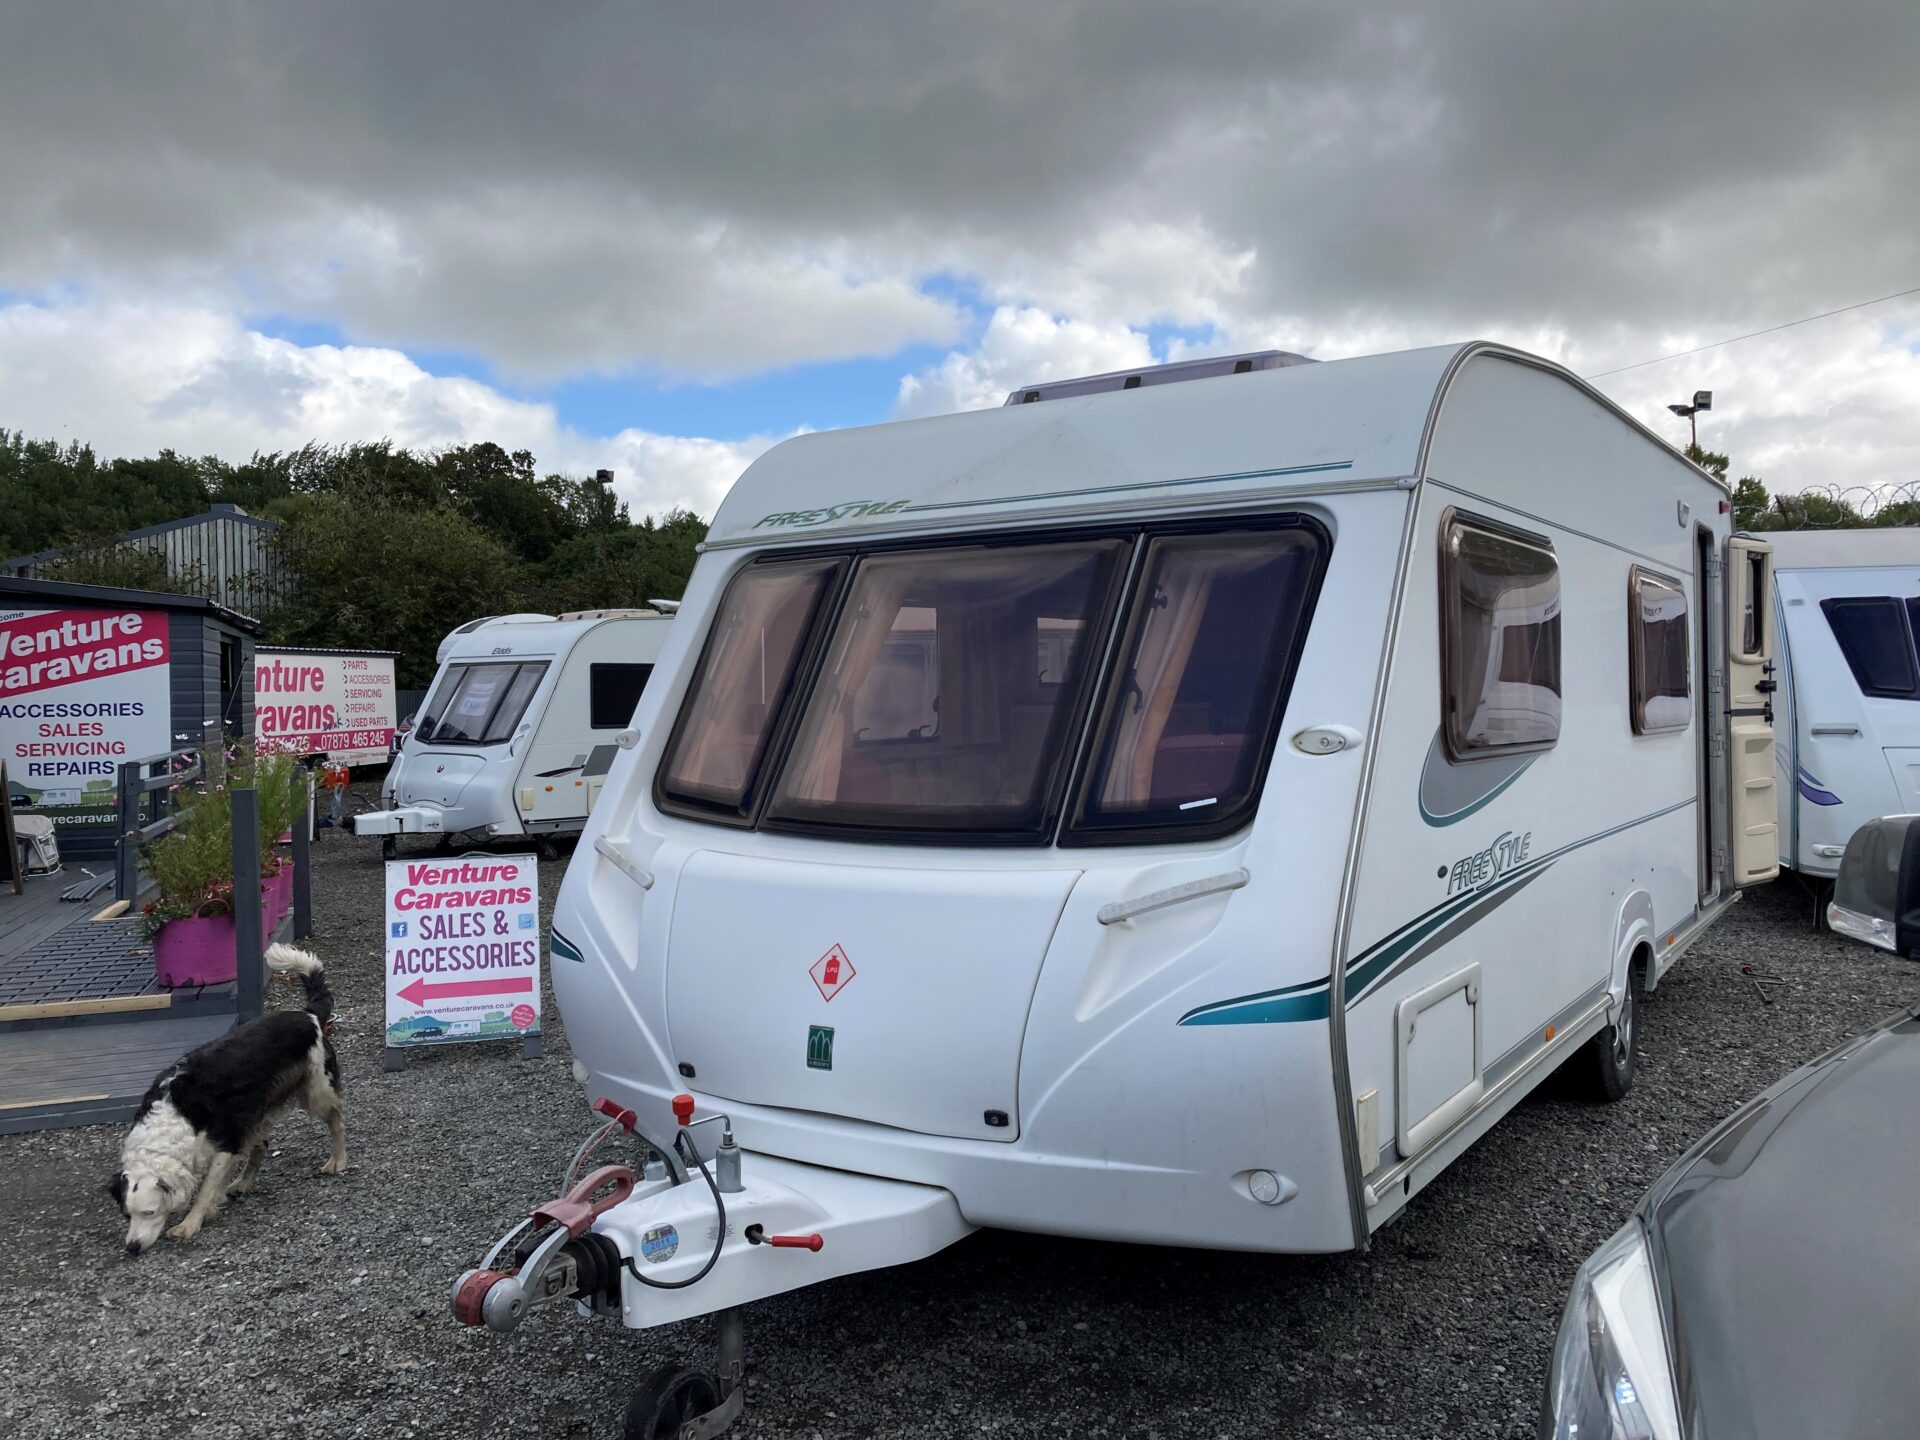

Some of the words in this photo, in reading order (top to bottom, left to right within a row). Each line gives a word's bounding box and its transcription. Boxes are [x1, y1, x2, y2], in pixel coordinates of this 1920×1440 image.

[0, 638, 164, 690] aravans
[347, 660, 368, 670] PARTS
[349, 674, 391, 685] ACCESSORIES
[349, 689, 382, 699] SERVICING
[0, 702, 144, 719] ACCESSORIES
[350, 703, 376, 713] REPAIRS
[38, 723, 103, 737] SALES
[351, 717, 368, 728] USED
[369, 716, 388, 726] PARTS
[321, 733, 350, 750] 07879
[352, 732, 369, 747] 465
[369, 730, 385, 746] 245
[15, 741, 125, 758] SERVICING
[28, 761, 115, 777] REPAIRS
[407, 863, 518, 886] Venture
[394, 887, 531, 911] Caravans
[419, 911, 486, 941] SALES
[493, 909, 509, 935] &
[392, 940, 536, 976] ACCESSORIES
[414, 1002, 515, 1015] www.venturecaravans.co.uk
[650, 1238, 671, 1250] 2011
